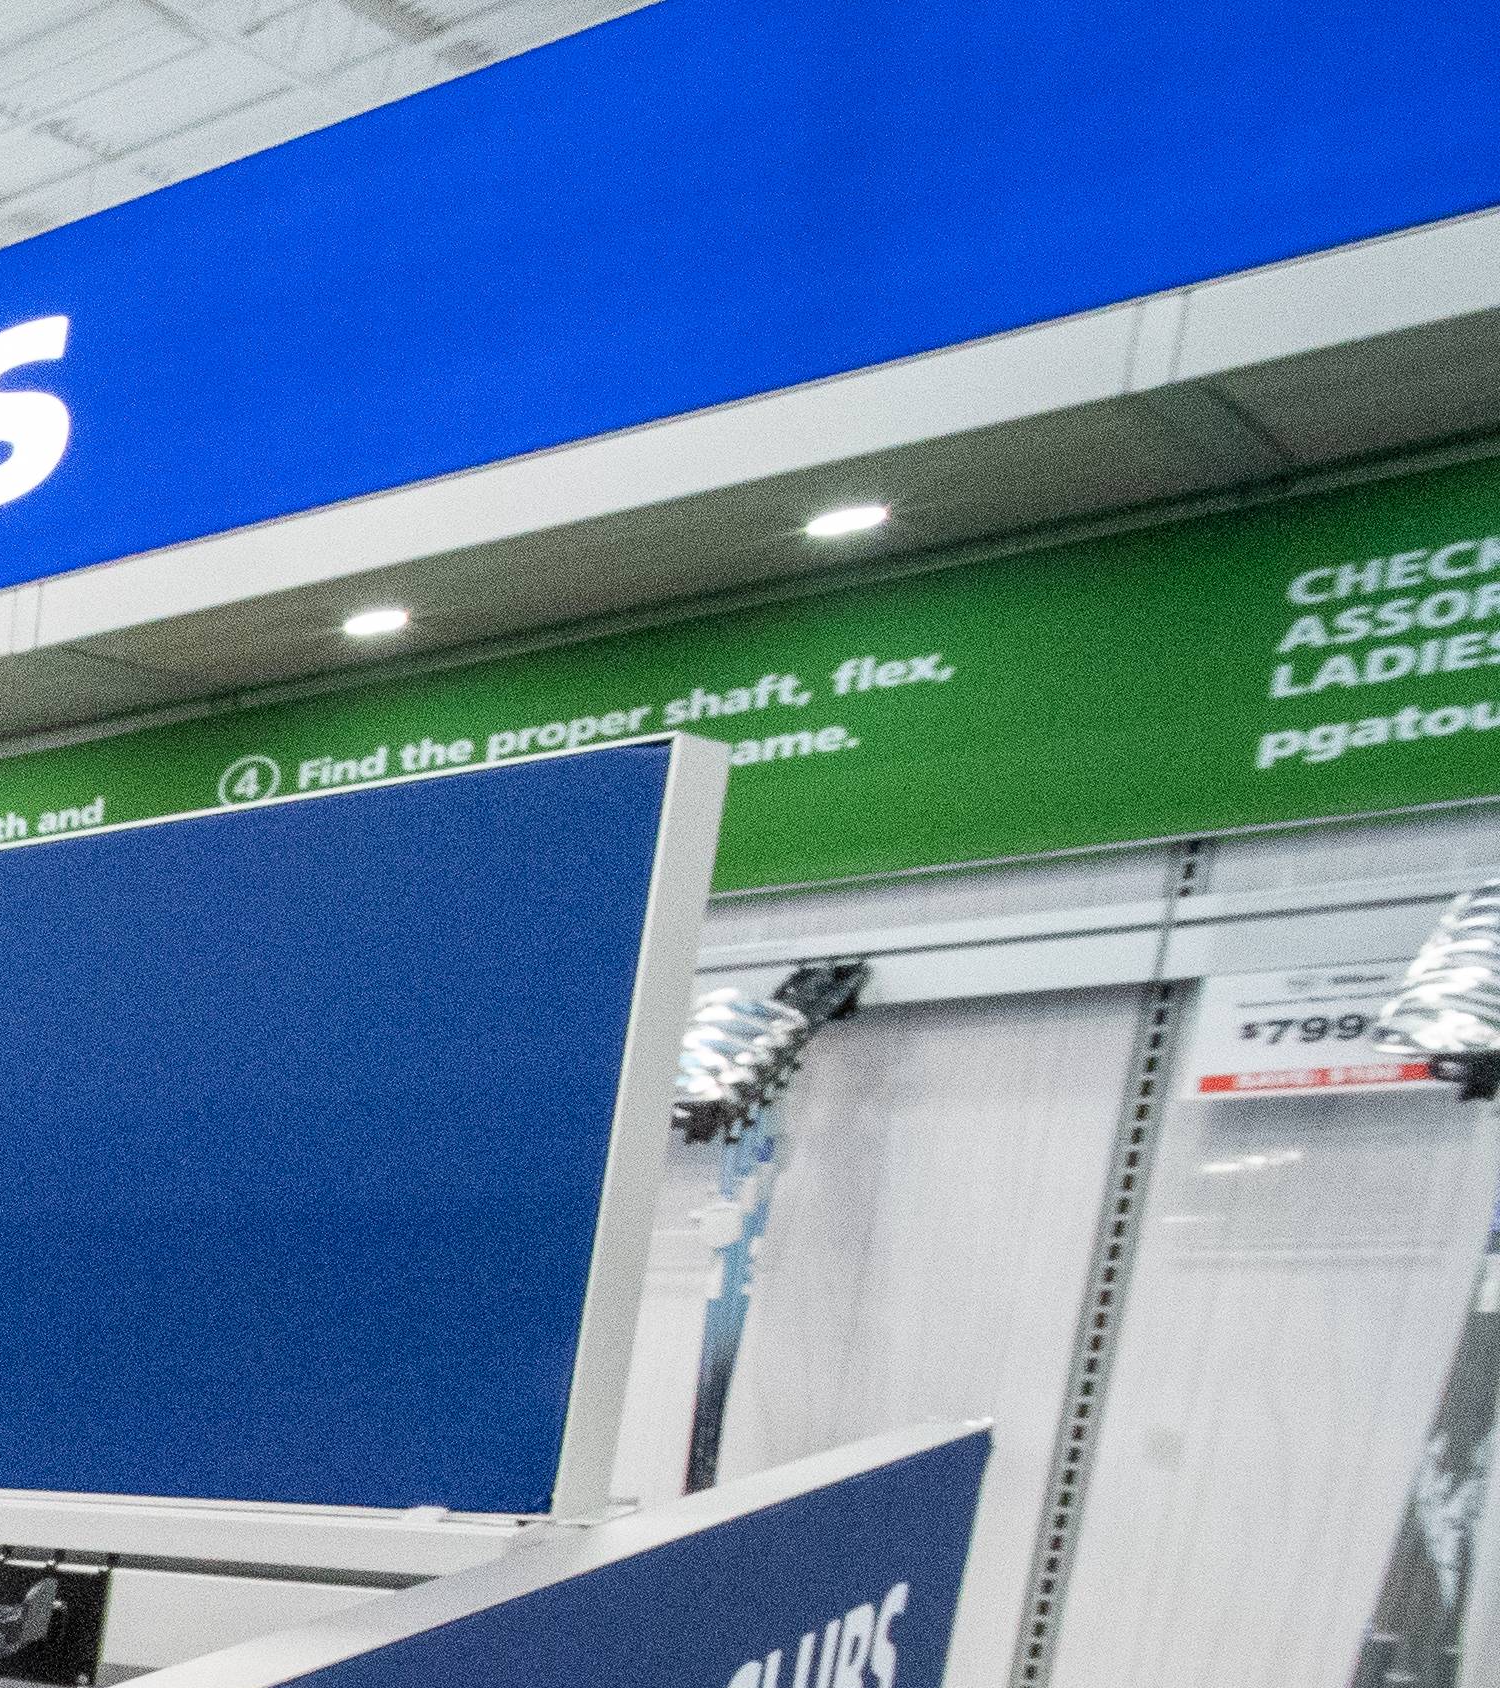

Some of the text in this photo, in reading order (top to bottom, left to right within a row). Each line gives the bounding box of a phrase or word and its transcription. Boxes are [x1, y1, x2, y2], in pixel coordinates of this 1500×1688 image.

[299, 745, 388, 790] Find
[399, 735, 474, 776] the
[484, 704, 652, 762] proper
[663, 673, 811, 725] shaft,
[830, 651, 956, 697] flex,
[37, 796, 106, 834] and
